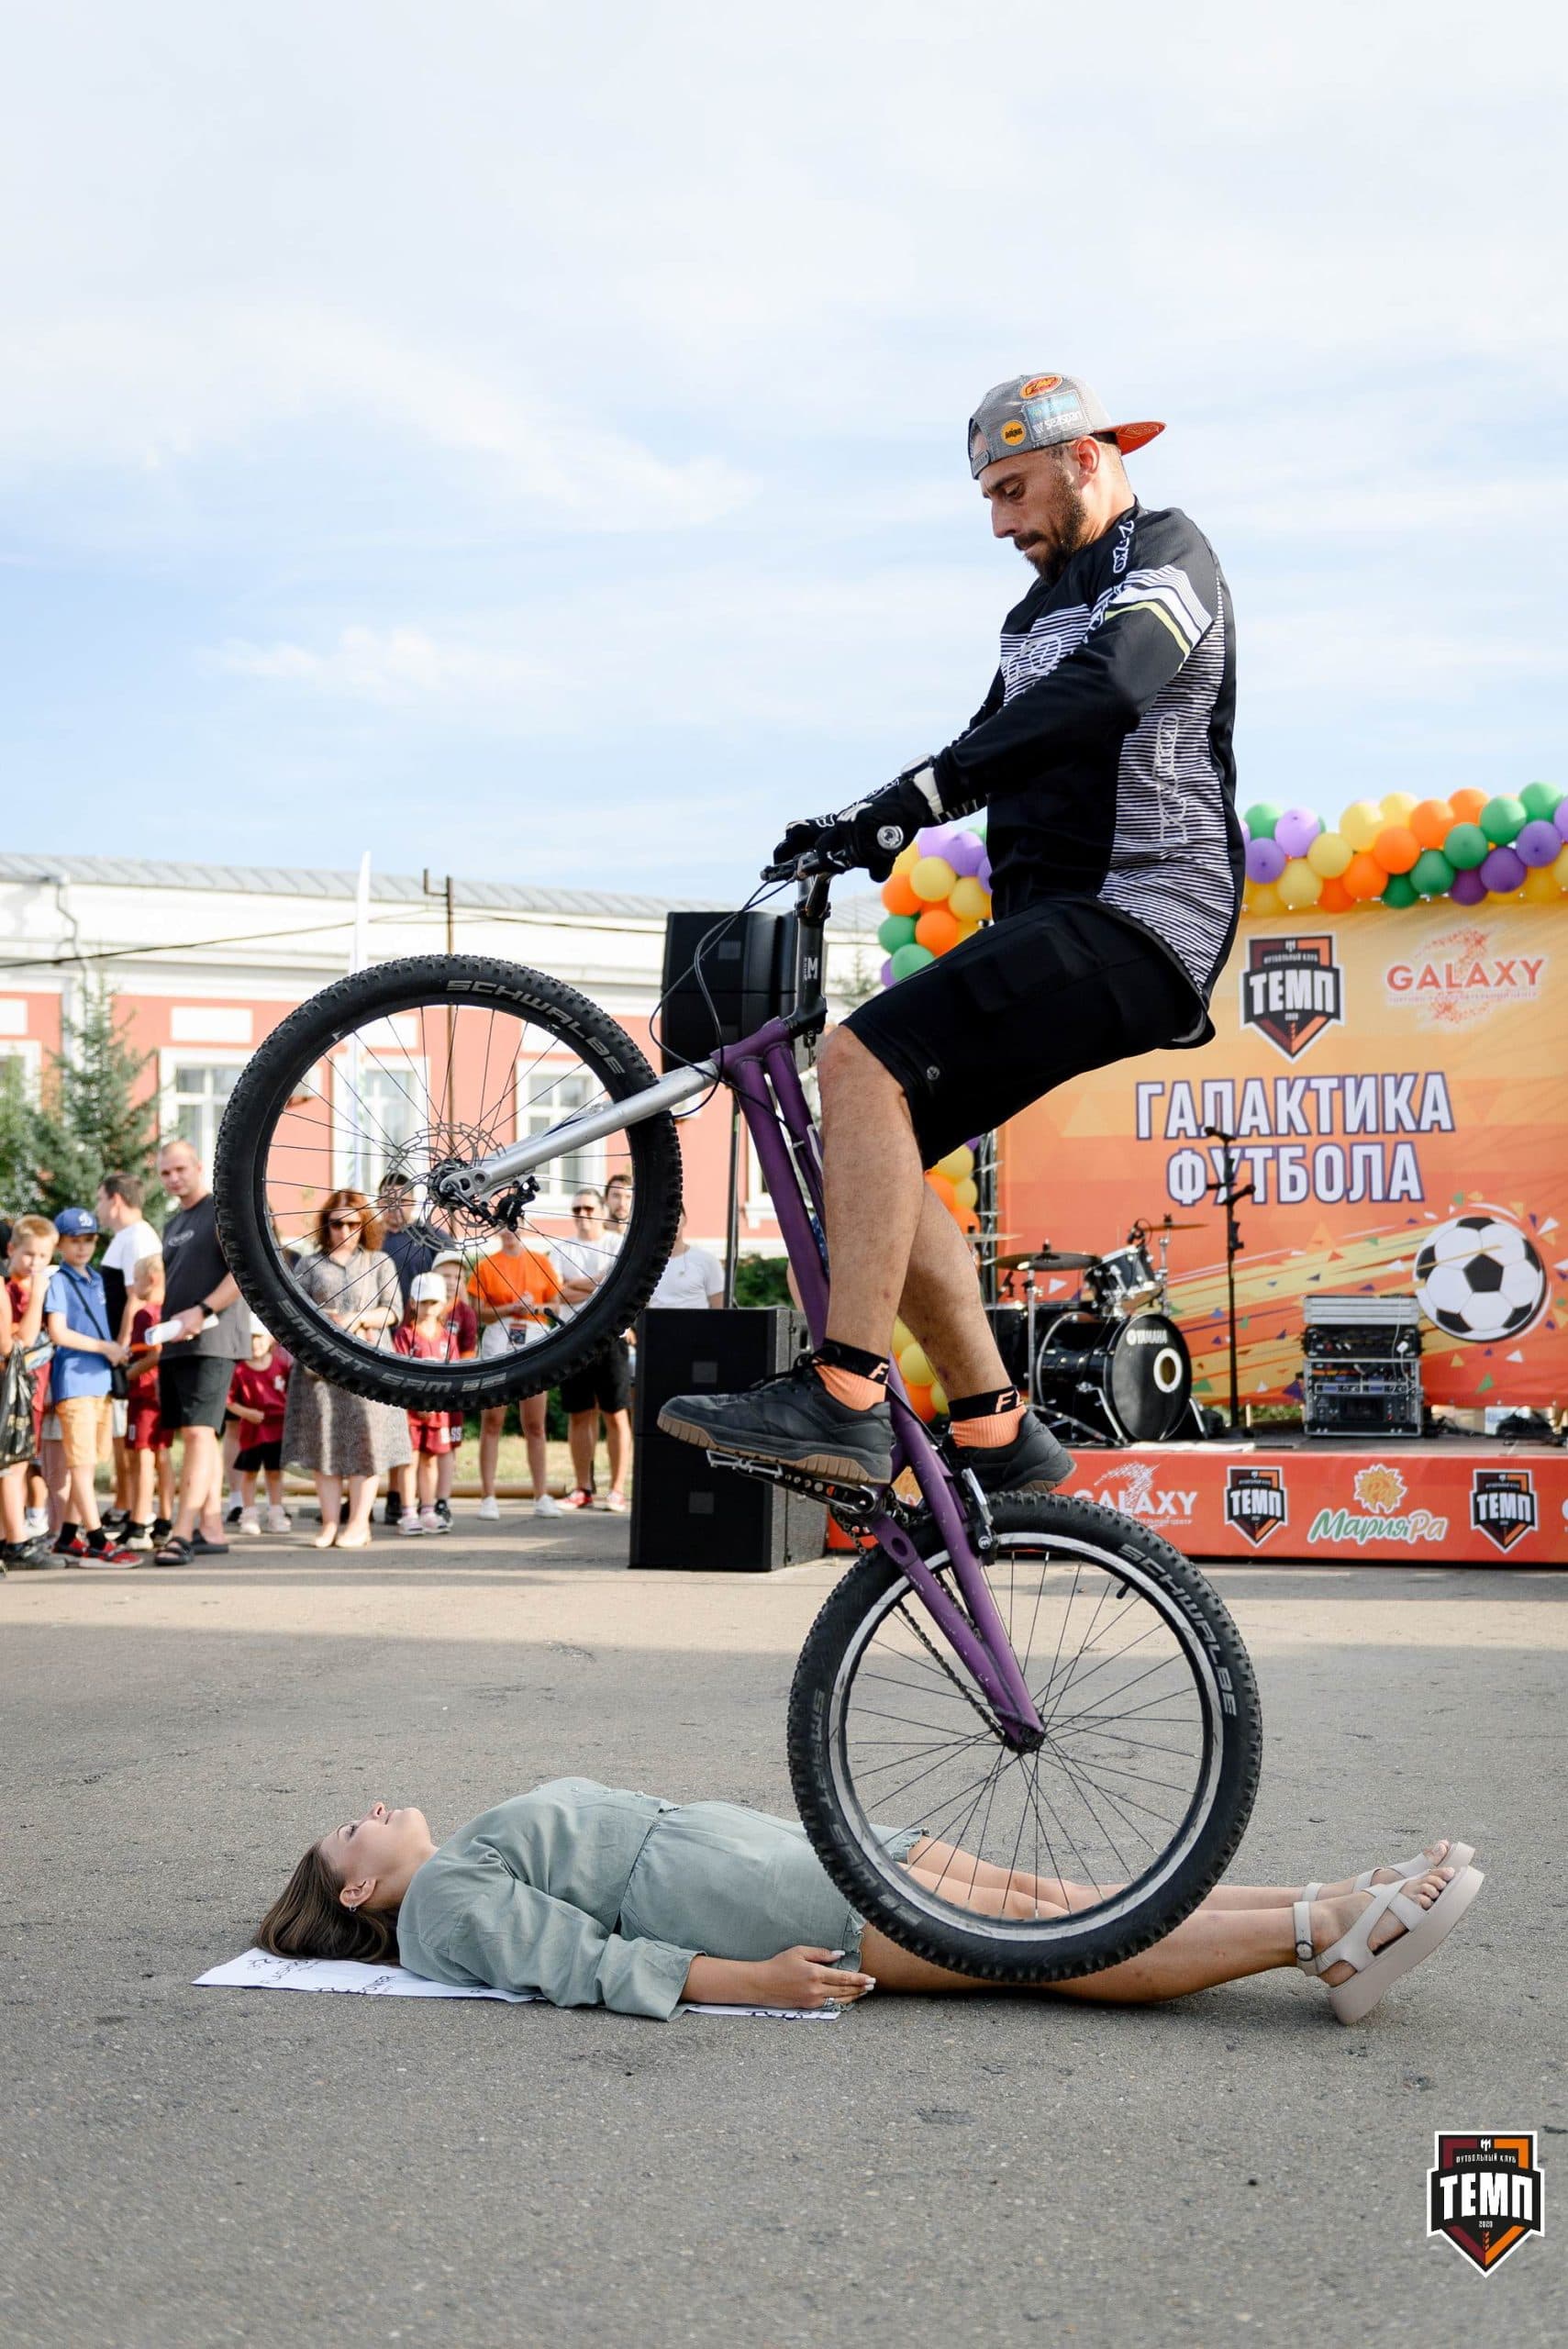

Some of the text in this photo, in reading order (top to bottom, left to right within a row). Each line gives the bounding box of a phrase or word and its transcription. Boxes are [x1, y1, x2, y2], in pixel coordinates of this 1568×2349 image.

[1249, 969, 1335, 1016] ТЕМП
[1386, 959, 1544, 991] GALAXY
[446, 979, 626, 1074] SCHWALBE
[1136, 1072, 1455, 1140] ГАЛАКТИКА
[1166, 1141, 1425, 1207] ФУТБОЛА
[278, 1299, 372, 1372] SMART
[380, 1373, 452, 1393] SAM
[1137, 1329, 1168, 1344] YAMAHA
[1230, 1488, 1282, 1517] ТЕМП
[1476, 1492, 1531, 1522] ТЕМП
[1118, 1543, 1237, 1717] SCHWALBE
